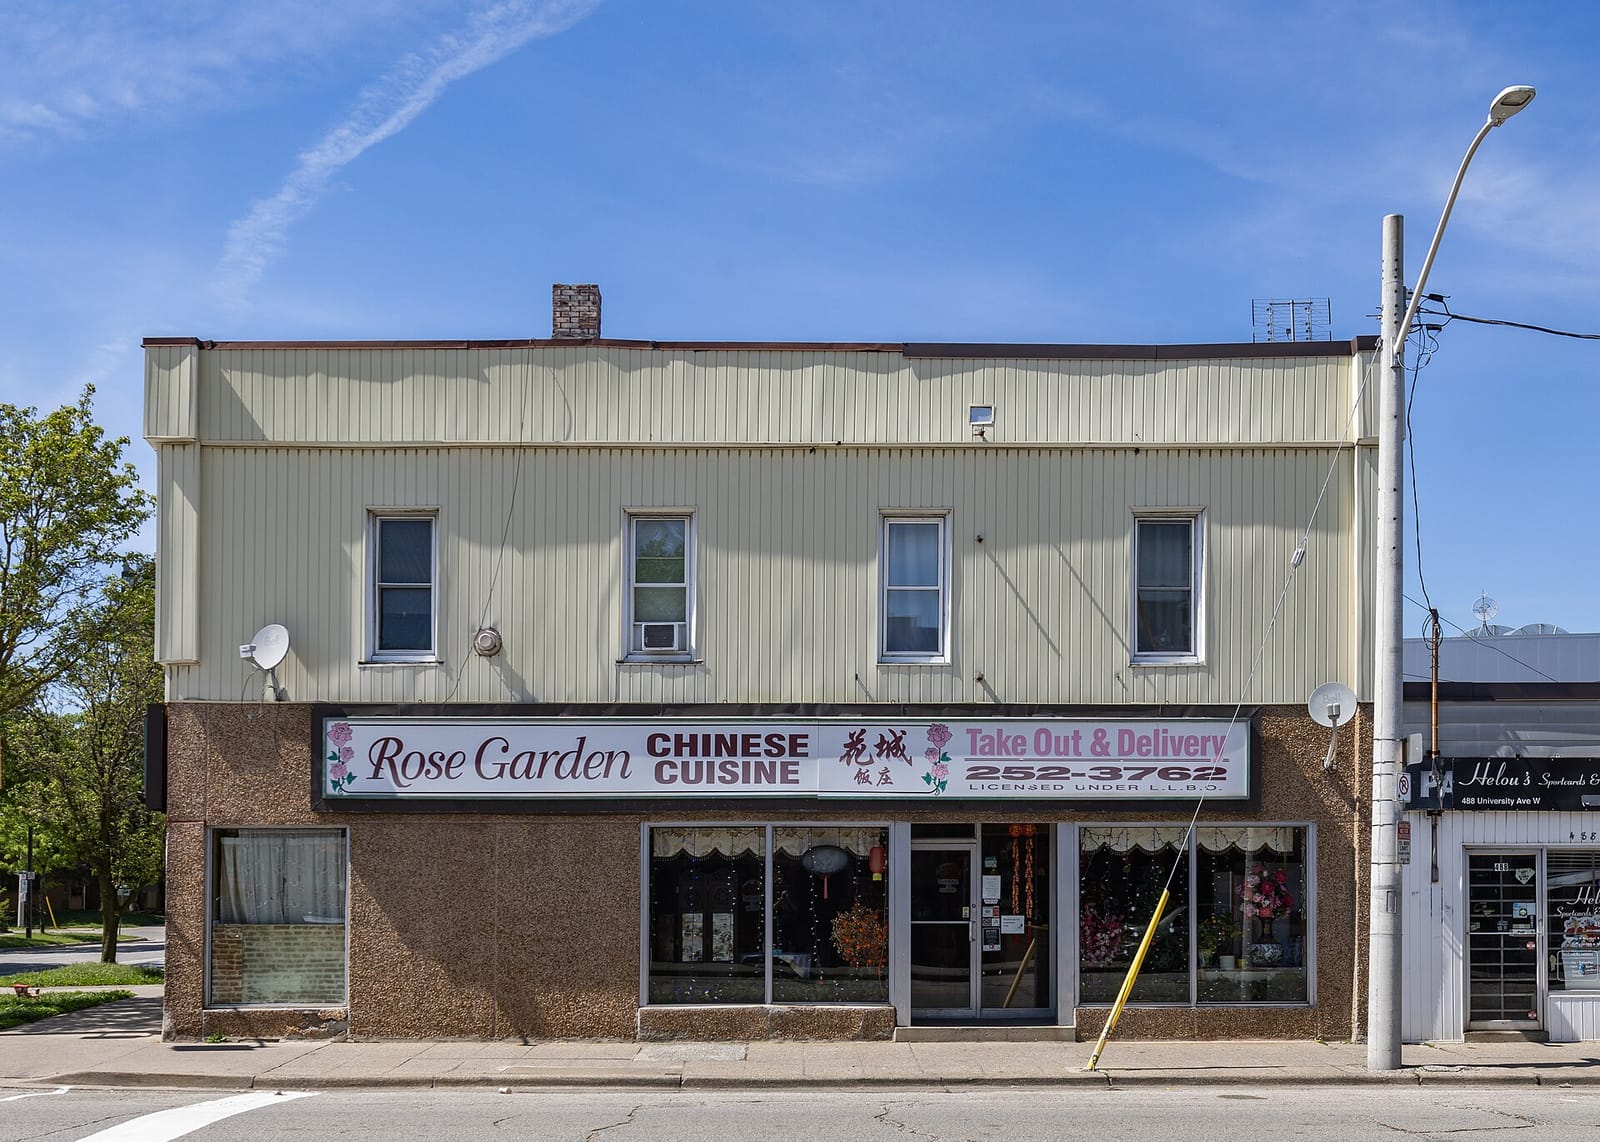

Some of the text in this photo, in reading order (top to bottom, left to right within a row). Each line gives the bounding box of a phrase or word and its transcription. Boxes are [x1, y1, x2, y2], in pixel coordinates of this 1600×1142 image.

[646, 733, 809, 758] CHINESE
[839, 728, 913, 767] 花城
[966, 728, 1227, 763] Take Out & Delivery
[365, 736, 633, 788] Rose Garden
[654, 760, 800, 784] CUISINE
[965, 765, 1228, 781] 252-3762
[1458, 761, 1531, 786] Helou's
[1538, 772, 1586, 789] Sportcards
[1461, 796, 1541, 807] 488 University Ave W
